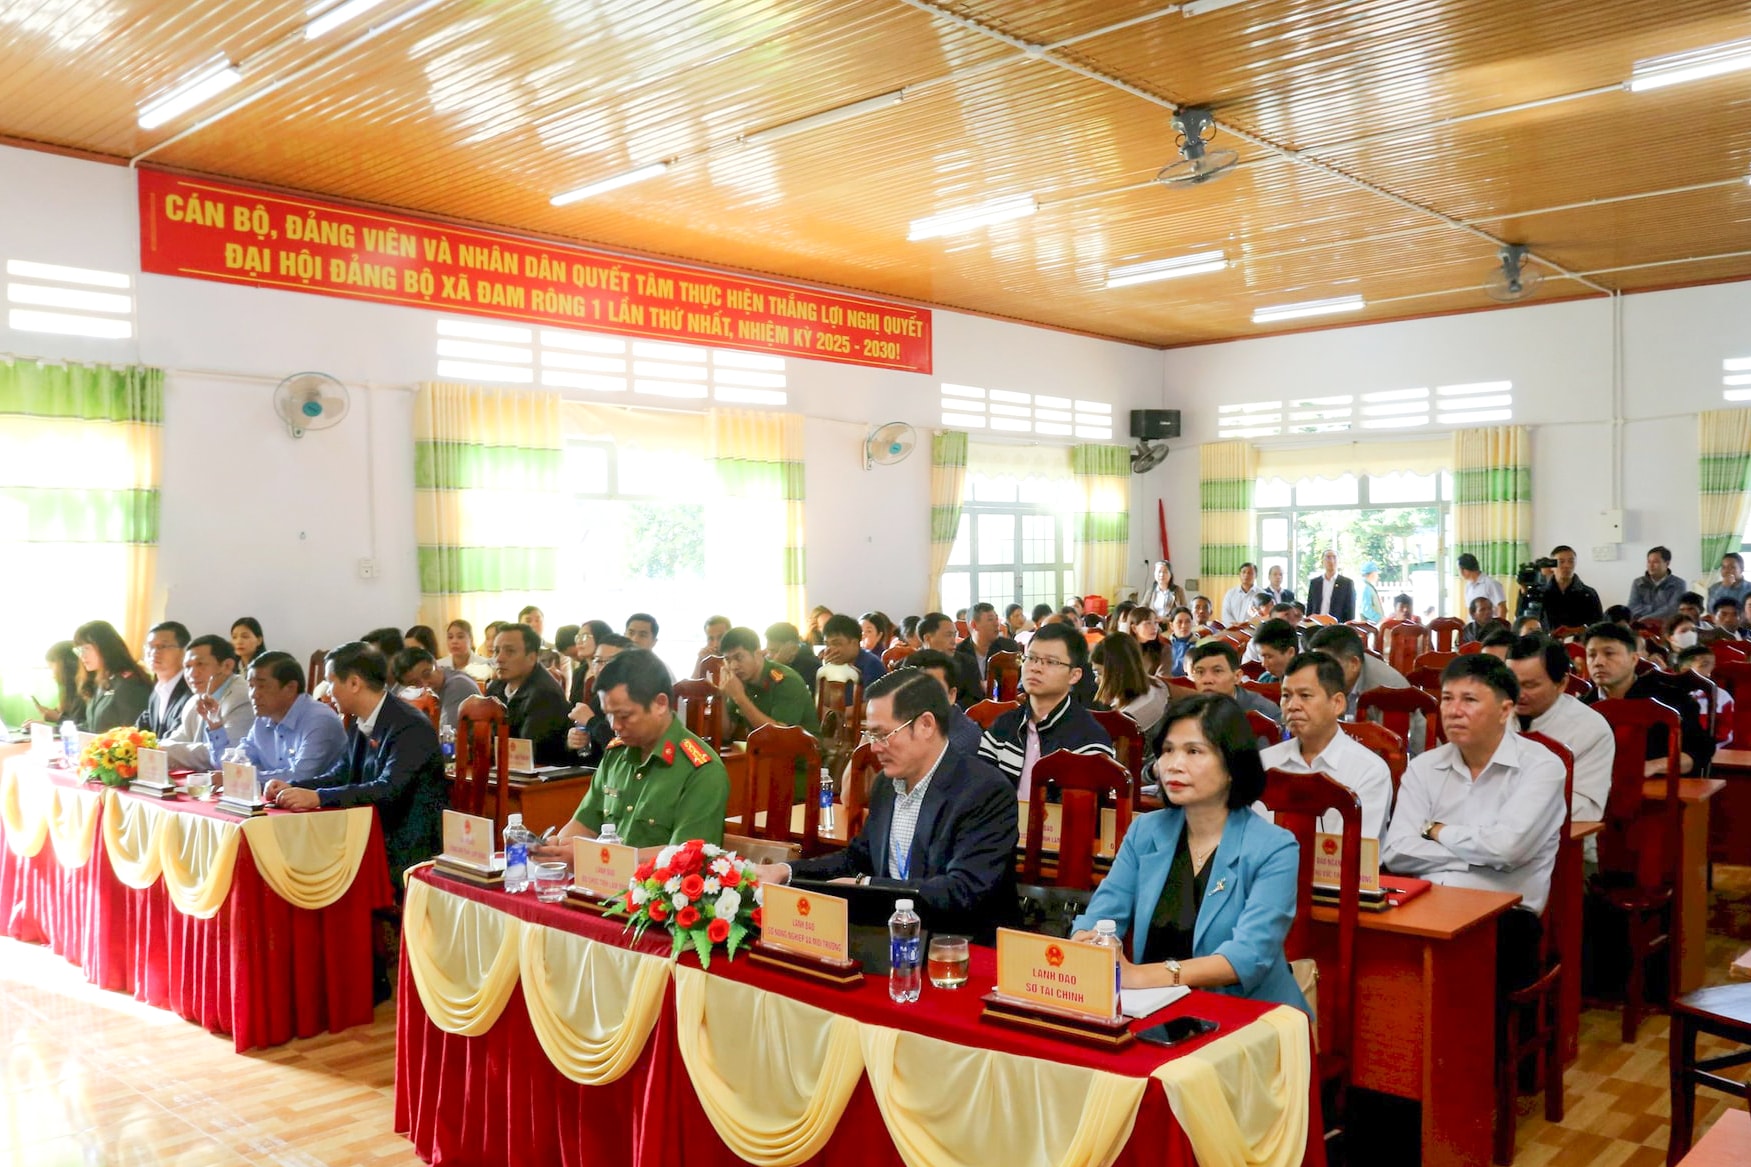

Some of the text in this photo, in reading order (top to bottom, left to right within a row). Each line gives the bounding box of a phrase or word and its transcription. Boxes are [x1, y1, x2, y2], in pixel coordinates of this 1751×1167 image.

[165, 193, 923, 338] CÁN BỘ, ĐẢNG VIÊN VÀ NHÂN DÂN QUYẾT TÂM THỰC HIỆN THẮNG LỢI NGHỊ QUYẾT
[225, 242, 271, 277] ĐẠI
[279, 249, 322, 283] HỘI
[330, 253, 397, 291] ĐẢNG
[404, 267, 435, 300] BỘ
[441, 273, 471, 301] XÃ
[477, 280, 525, 309] ĐAM
[531, 287, 586, 318] RÔNG
[592, 299, 601, 320] 1
[608, 296, 644, 326] LẦN
[649, 306, 684, 331] THỨ
[687, 310, 734, 339] NHẤT,
[738, 320, 789, 347] NHIỆM
[793, 325, 812, 348] KỲ
[816, 331, 850, 353] 2025
[863, 339, 901, 361] 2030!
